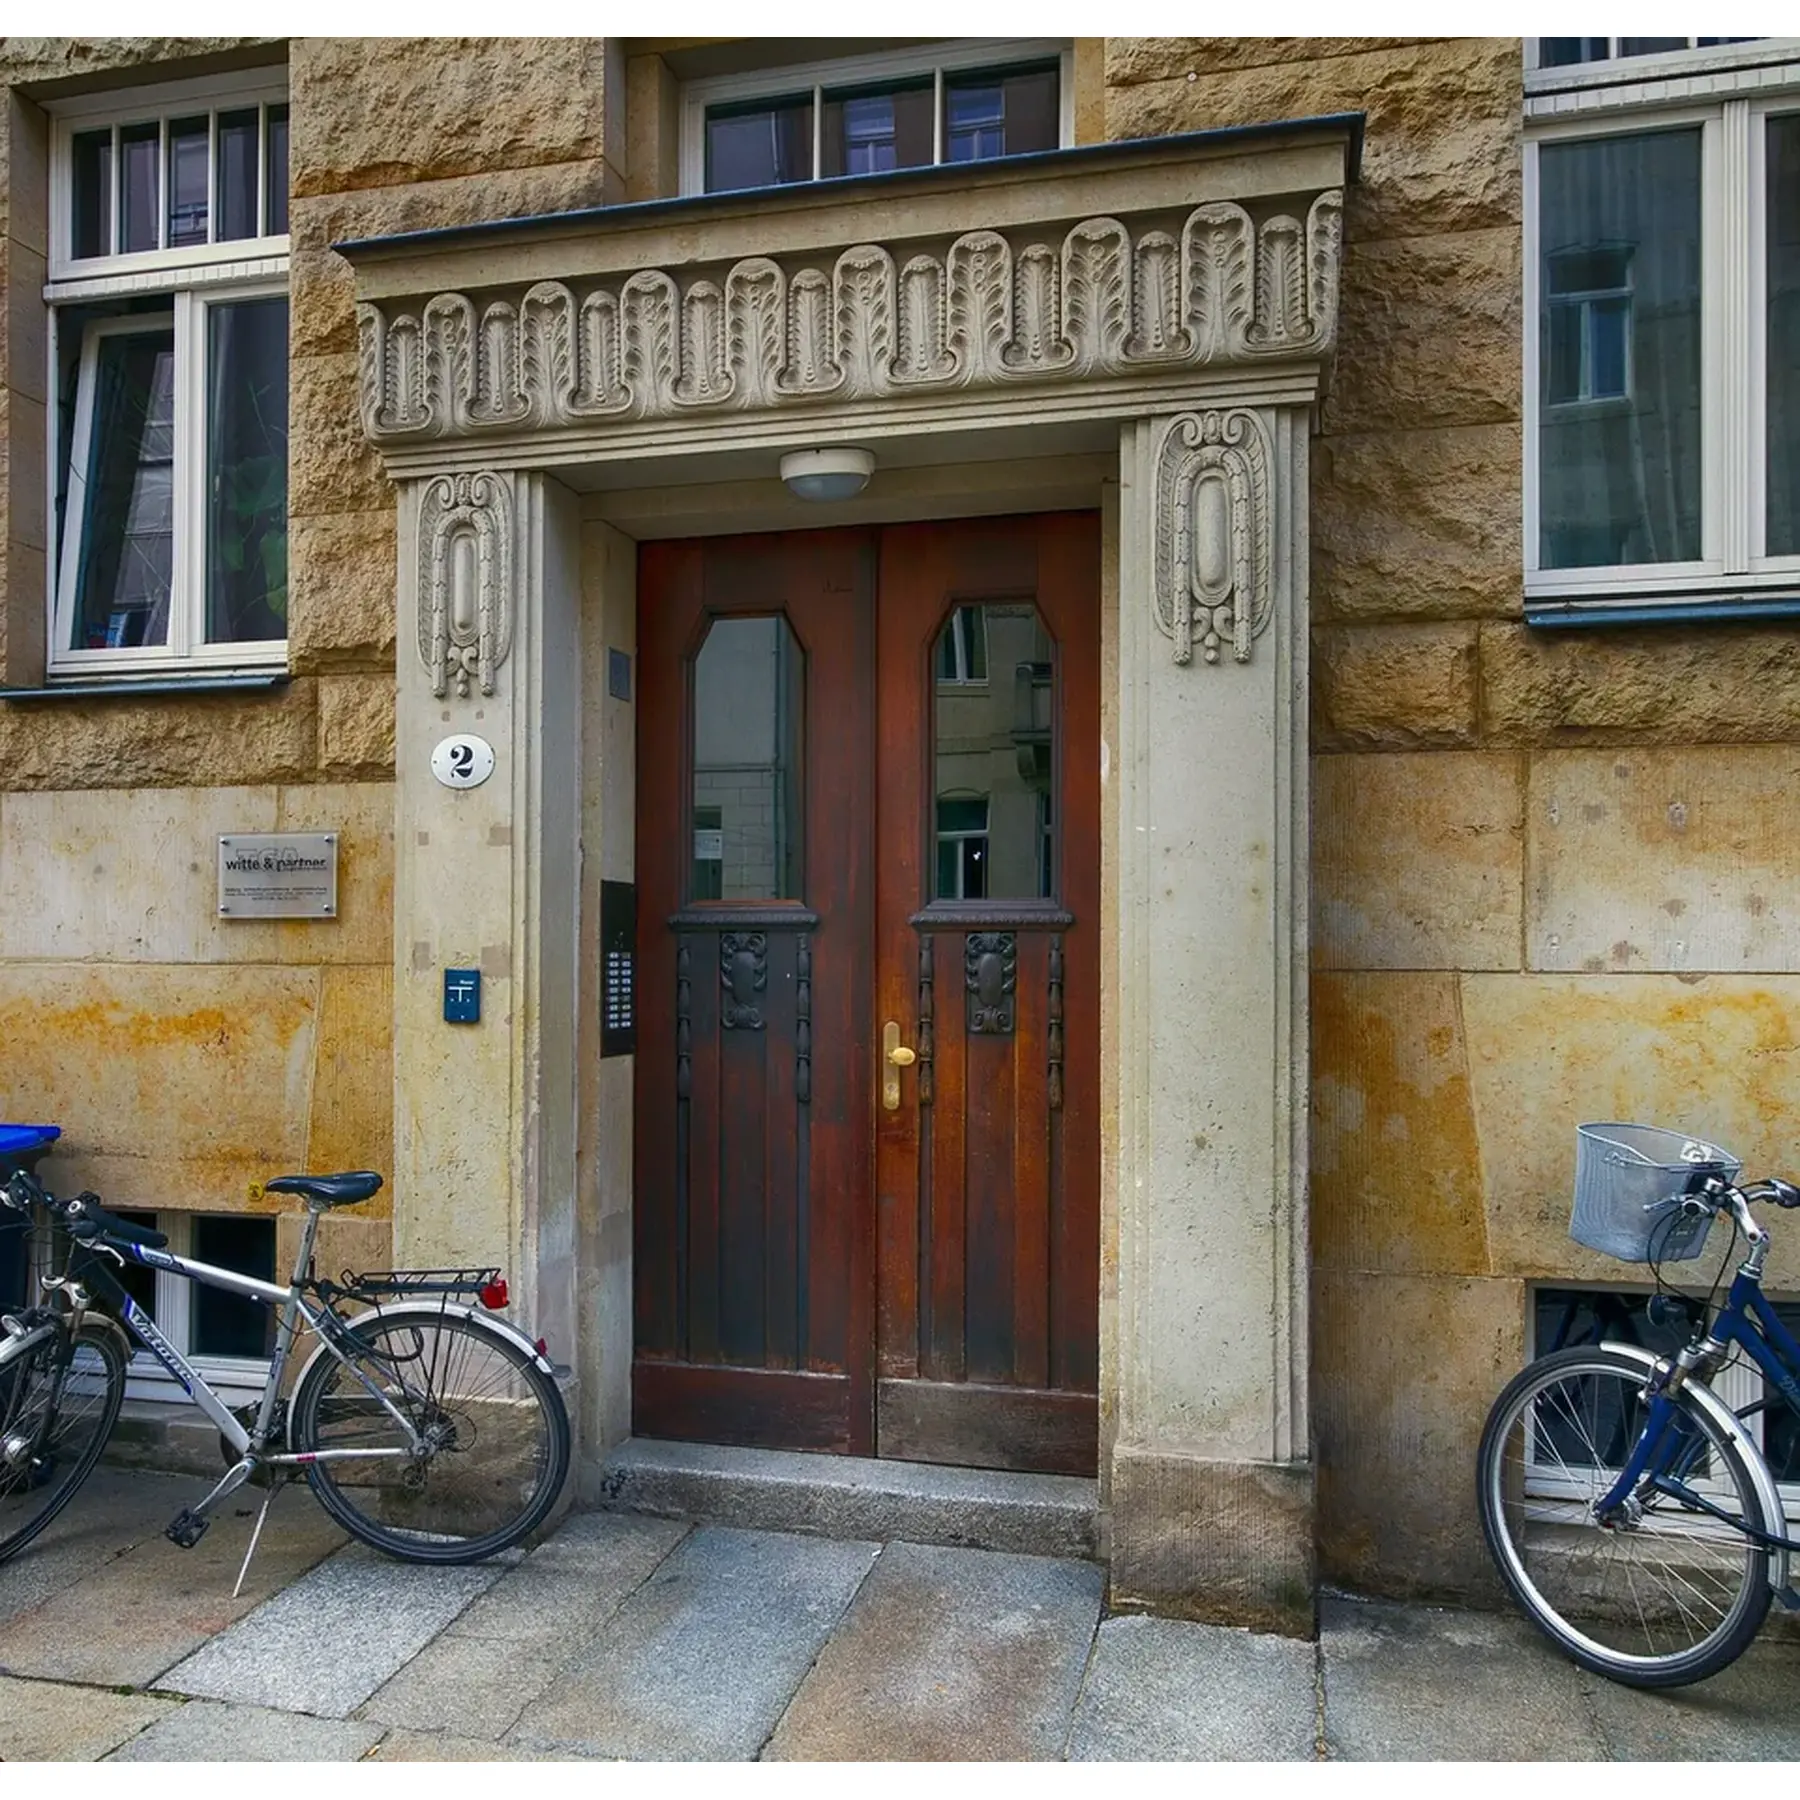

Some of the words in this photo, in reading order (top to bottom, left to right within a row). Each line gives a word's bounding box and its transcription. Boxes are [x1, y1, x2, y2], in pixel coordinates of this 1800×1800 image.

[450, 743, 473, 778] 2
[225, 857, 260, 870] witte
[263, 857, 273, 870] &
[276, 857, 326, 872] partner
